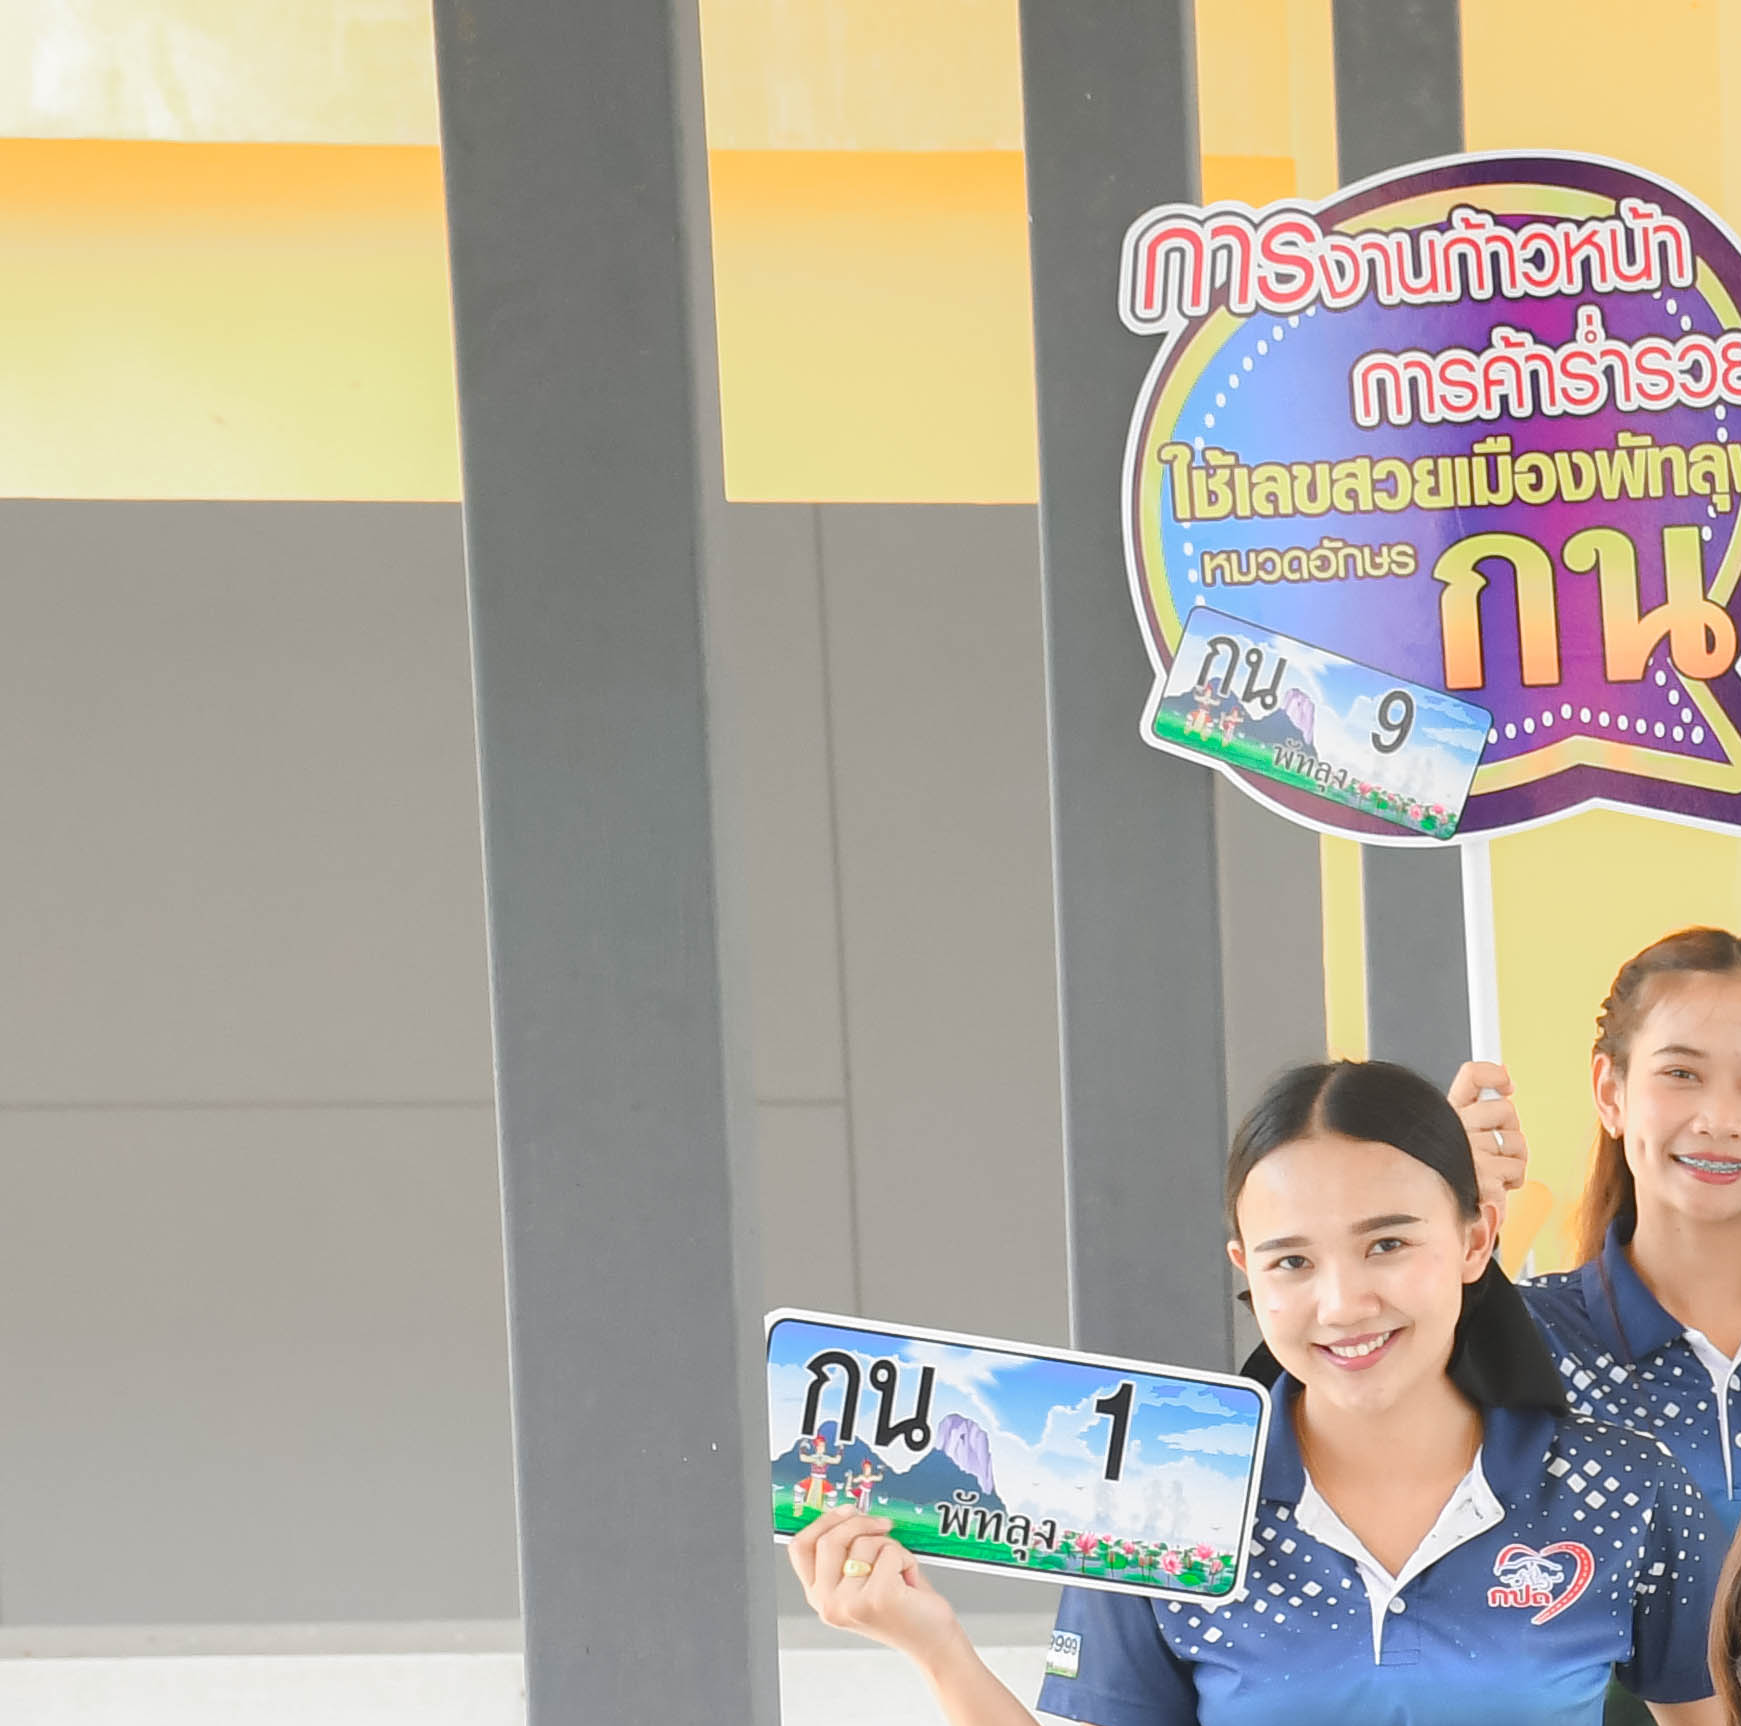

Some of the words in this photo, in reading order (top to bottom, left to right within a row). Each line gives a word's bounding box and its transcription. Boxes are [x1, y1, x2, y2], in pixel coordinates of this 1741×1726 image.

[1142, 201, 1692, 316] การงานก้าวหน้า
[1203, 538, 1415, 587] หมวดอักษร
[1432, 525, 1738, 690] กน
[1198, 636, 1284, 708] กน
[1371, 690, 1415, 754] 9
[1273, 734, 1349, 794] พัทลุง
[801, 1350, 935, 1452] กน
[1095, 1381, 1134, 1482] 1
[937, 1490, 1057, 1562] พัทลุง
